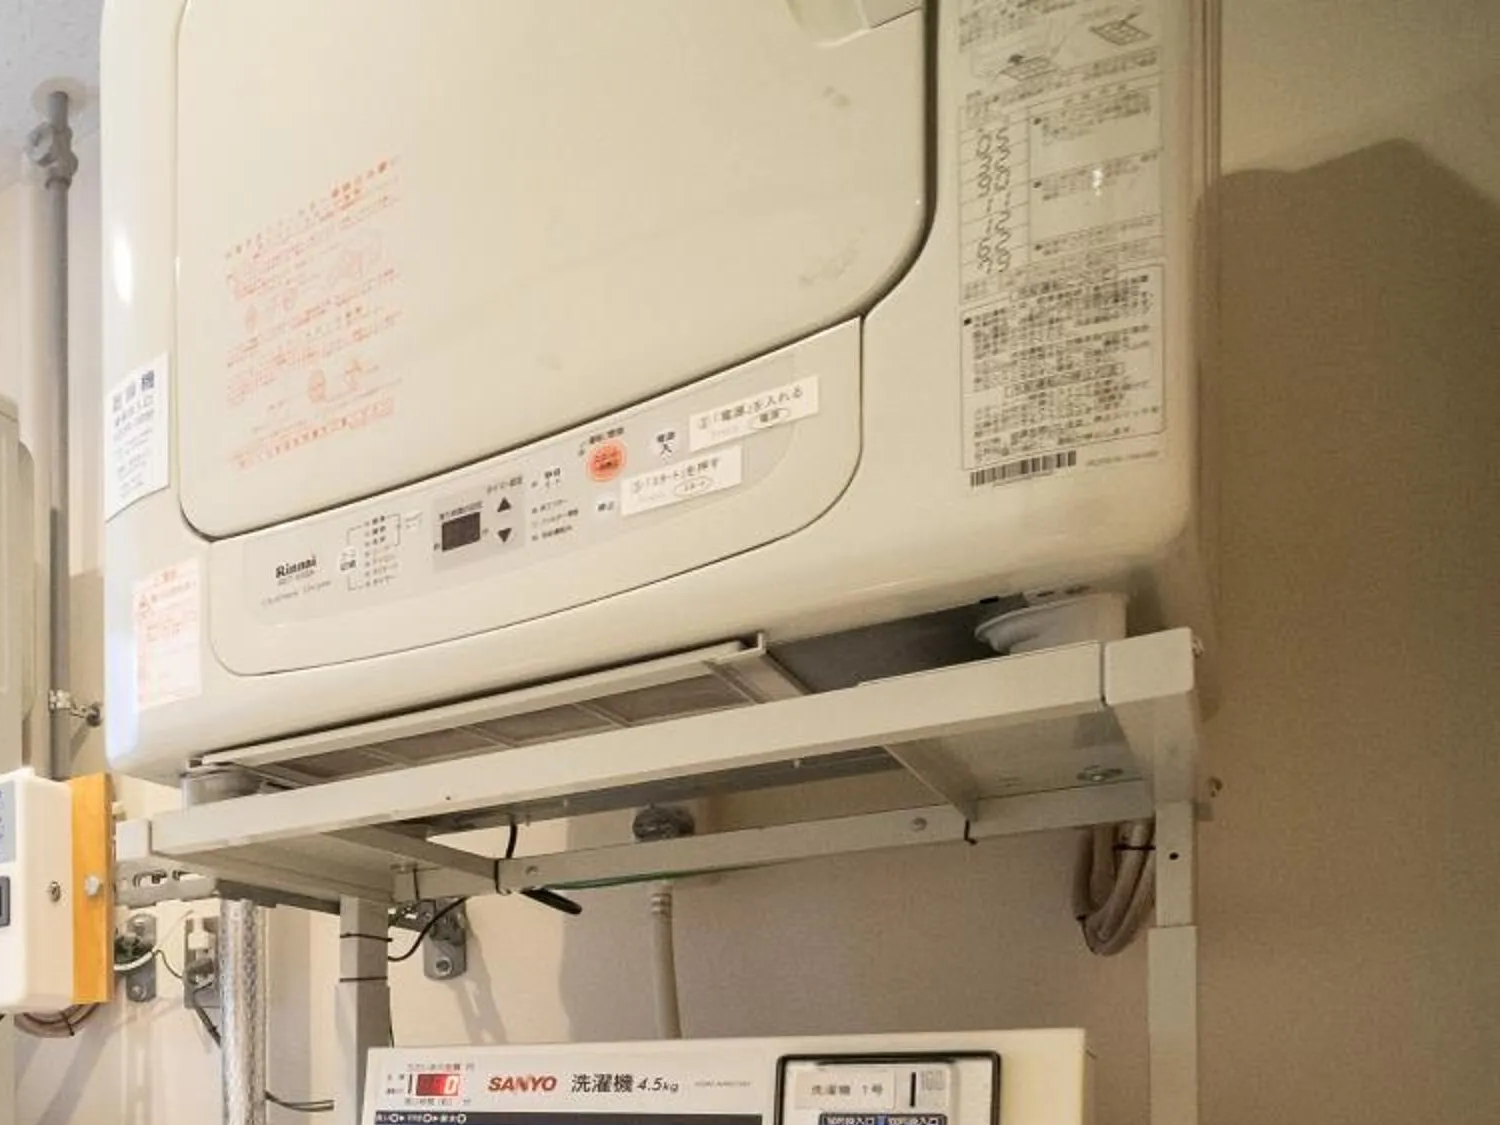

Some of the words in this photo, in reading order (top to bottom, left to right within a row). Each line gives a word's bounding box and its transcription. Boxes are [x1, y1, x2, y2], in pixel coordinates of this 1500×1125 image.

[275, 555, 317, 578] Rinnai
[488, 1075, 557, 1092] SANYO
[571, 1073, 633, 1093] 洗濯機
[636, 1077, 679, 1093] 4.5kg
